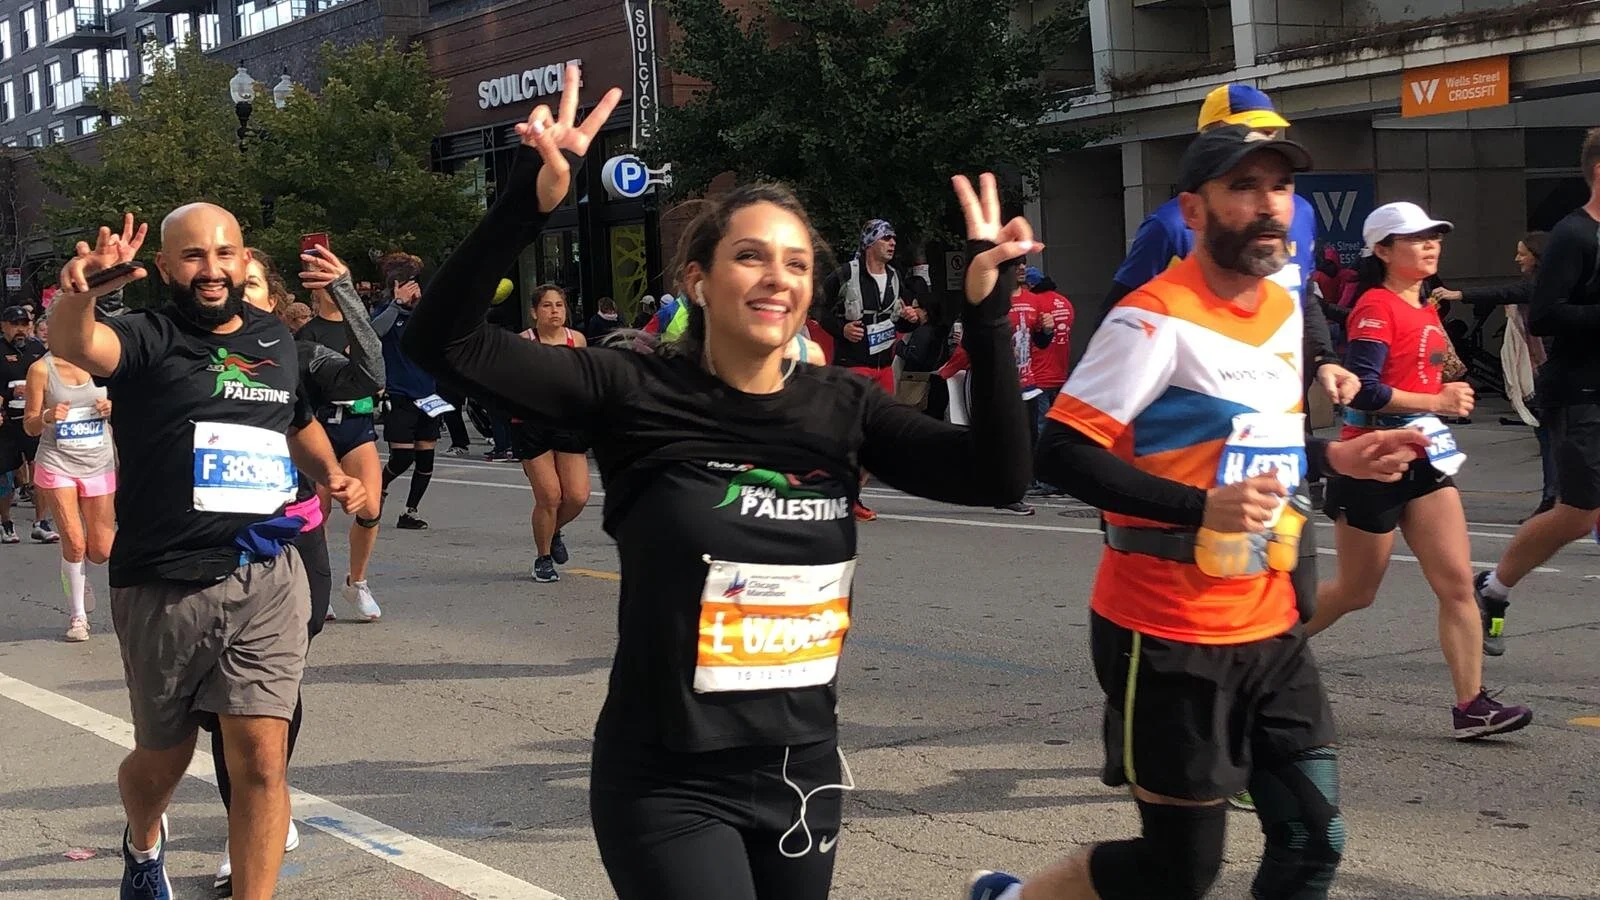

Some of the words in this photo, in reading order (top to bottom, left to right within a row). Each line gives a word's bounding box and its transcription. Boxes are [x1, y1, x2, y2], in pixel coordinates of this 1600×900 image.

[635, 9, 651, 137] SOULCYCLE
[1446, 76, 1471, 89] Wells
[1473, 71, 1500, 85] Street
[1449, 84, 1497, 102] CROSSFIT
[621, 161, 641, 190] P
[223, 380, 244, 388] TEAM
[223, 386, 290, 404] PALESTINE
[202, 453, 218, 480] F
[740, 485, 777, 499] TEAM
[740, 497, 849, 520] PALESTINE
[713, 611, 734, 654] L
